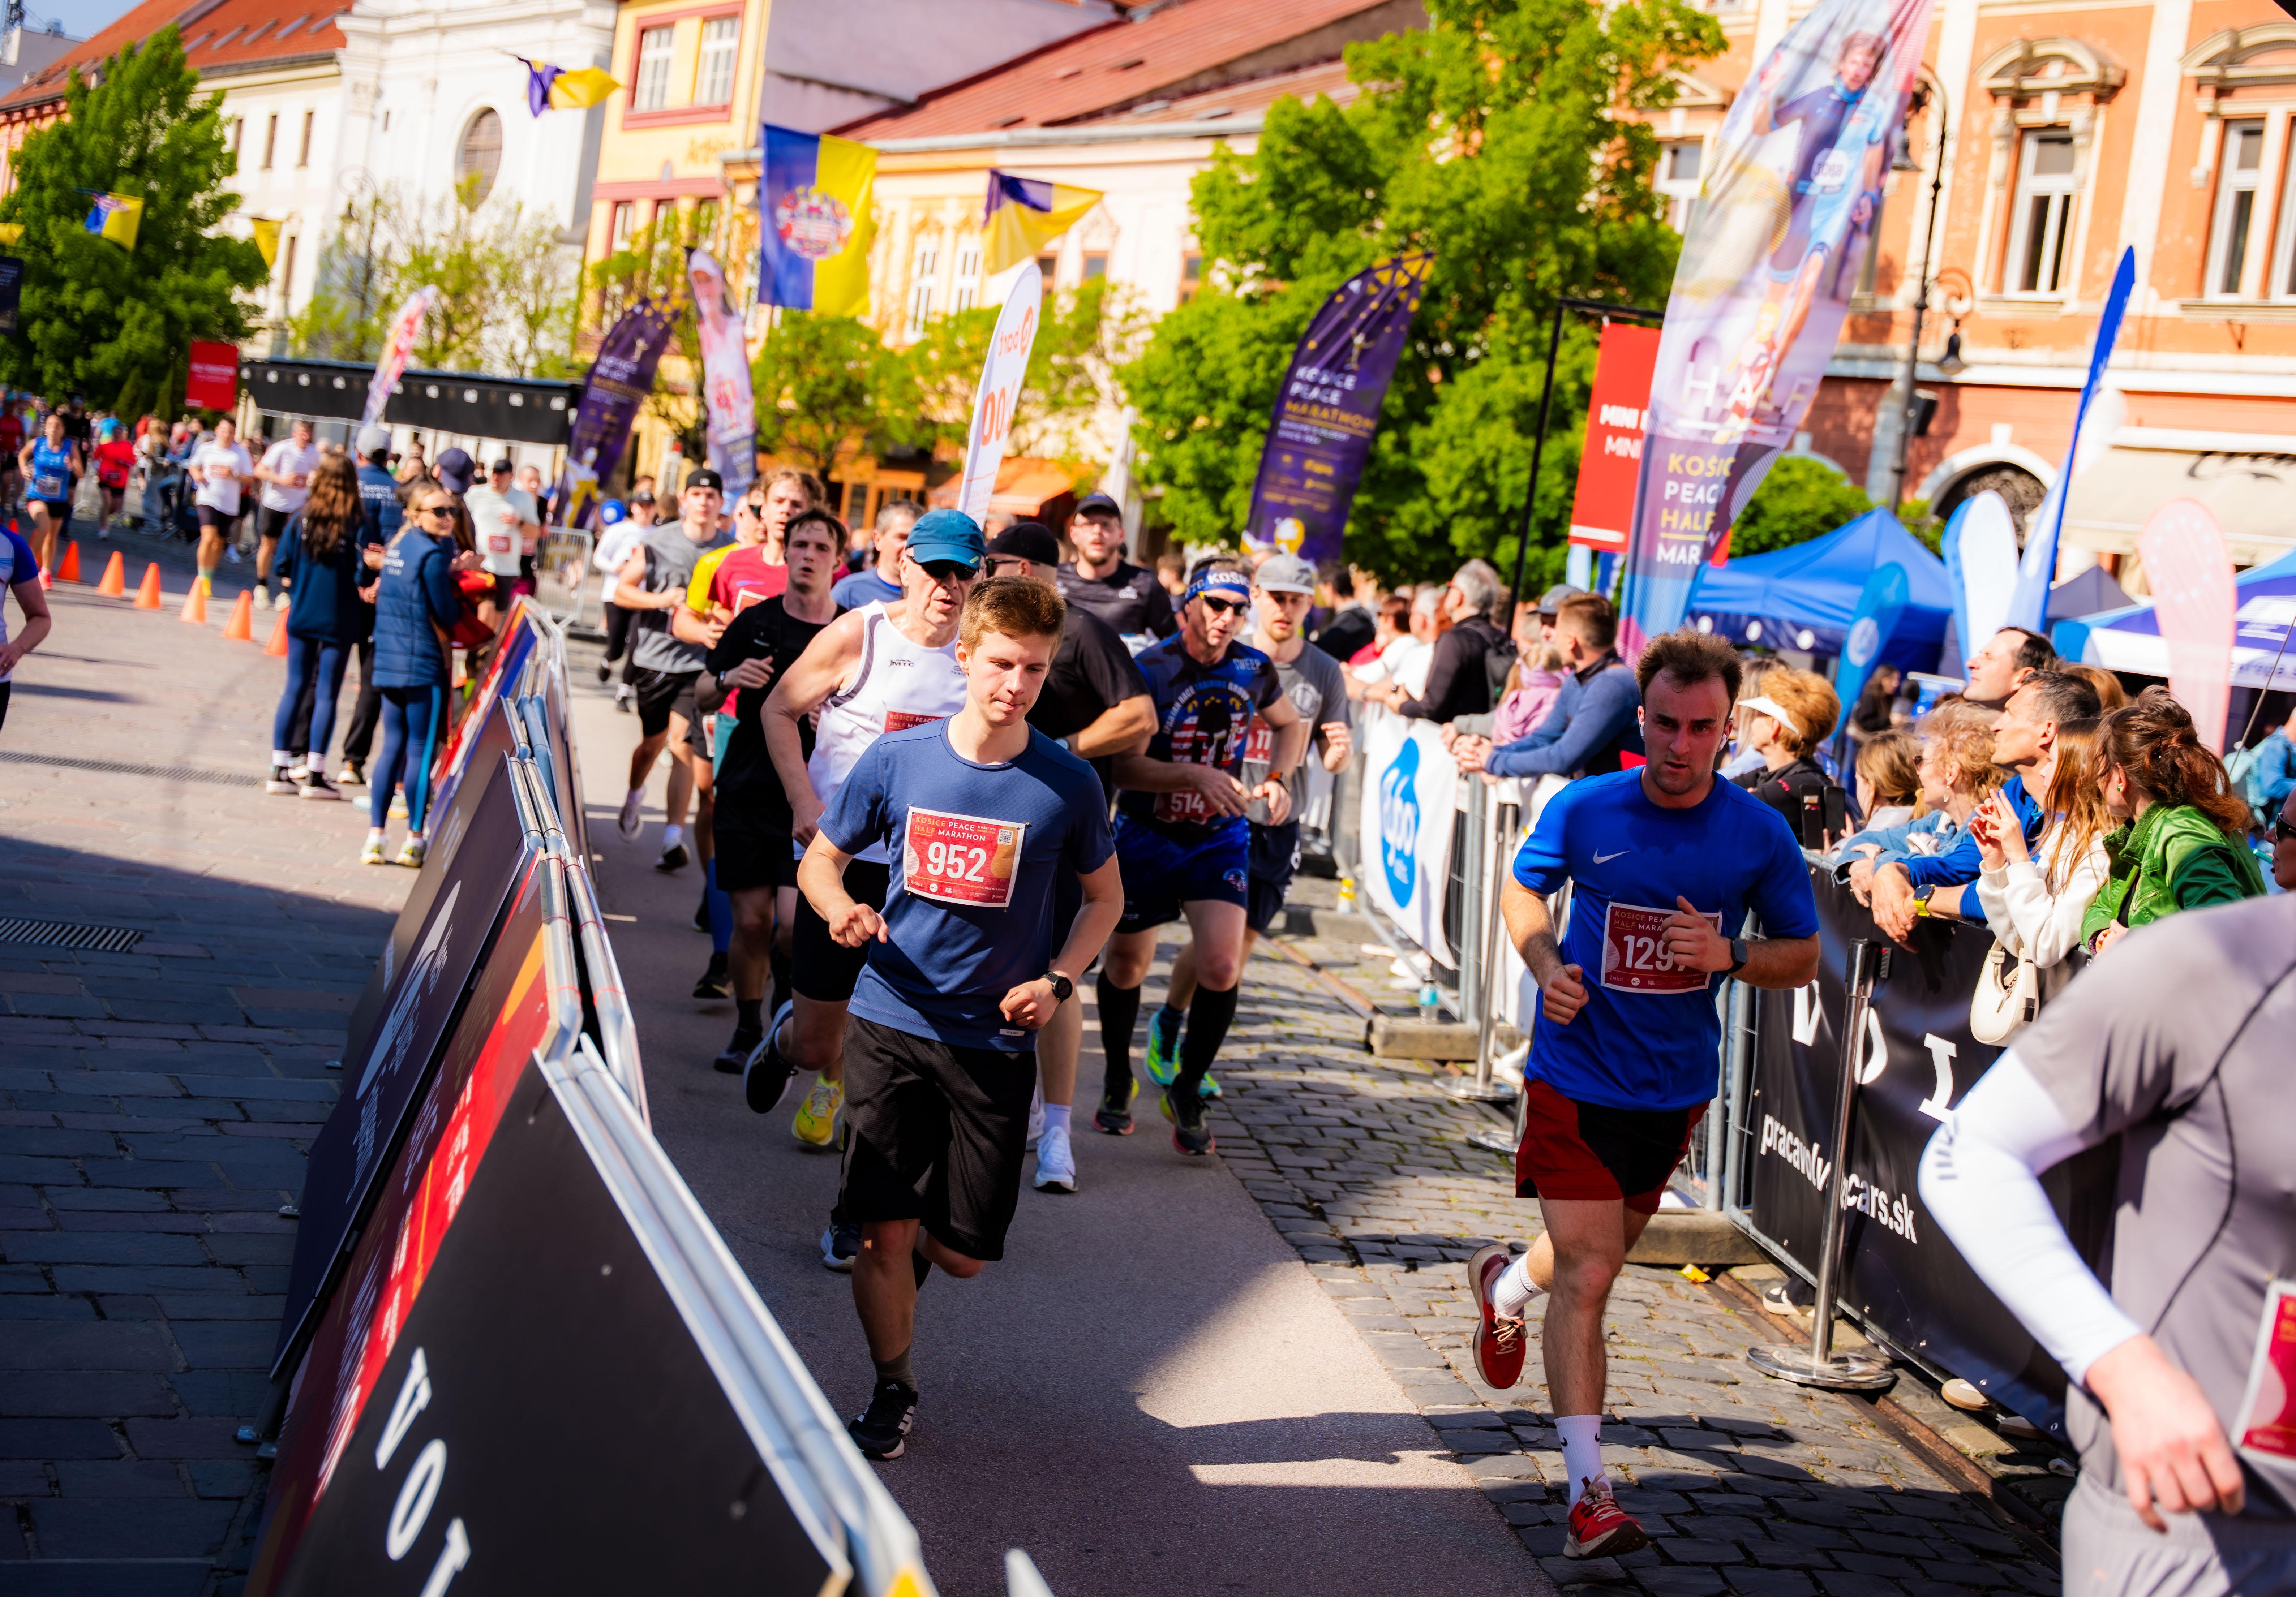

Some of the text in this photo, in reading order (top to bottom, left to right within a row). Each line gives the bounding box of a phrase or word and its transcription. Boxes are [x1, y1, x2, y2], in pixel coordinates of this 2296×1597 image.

[1289, 381, 1343, 405] PEACE
[1284, 399, 1374, 430] MARATHON
[1600, 403, 1638, 430] MINI
[1661, 508, 1717, 532] HALF
[1233, 658, 1261, 670] SWEEP
[1162, 700, 1182, 735] SPARTAN
[1177, 685, 1196, 704] RACE
[1228, 681, 1250, 701] GROUP
[1170, 793, 1205, 814] 514
[914, 825, 936, 834] HALF
[938, 829, 986, 842] MARATHON
[915, 816, 947, 827] KOŠICE
[948, 821, 975, 831] PEACE
[927, 841, 987, 882] 952
[1614, 919, 1636, 928] HALF
[1615, 911, 1645, 921] KOŠICE
[1760, 1114, 1917, 1244] pracavolvcars.sk
